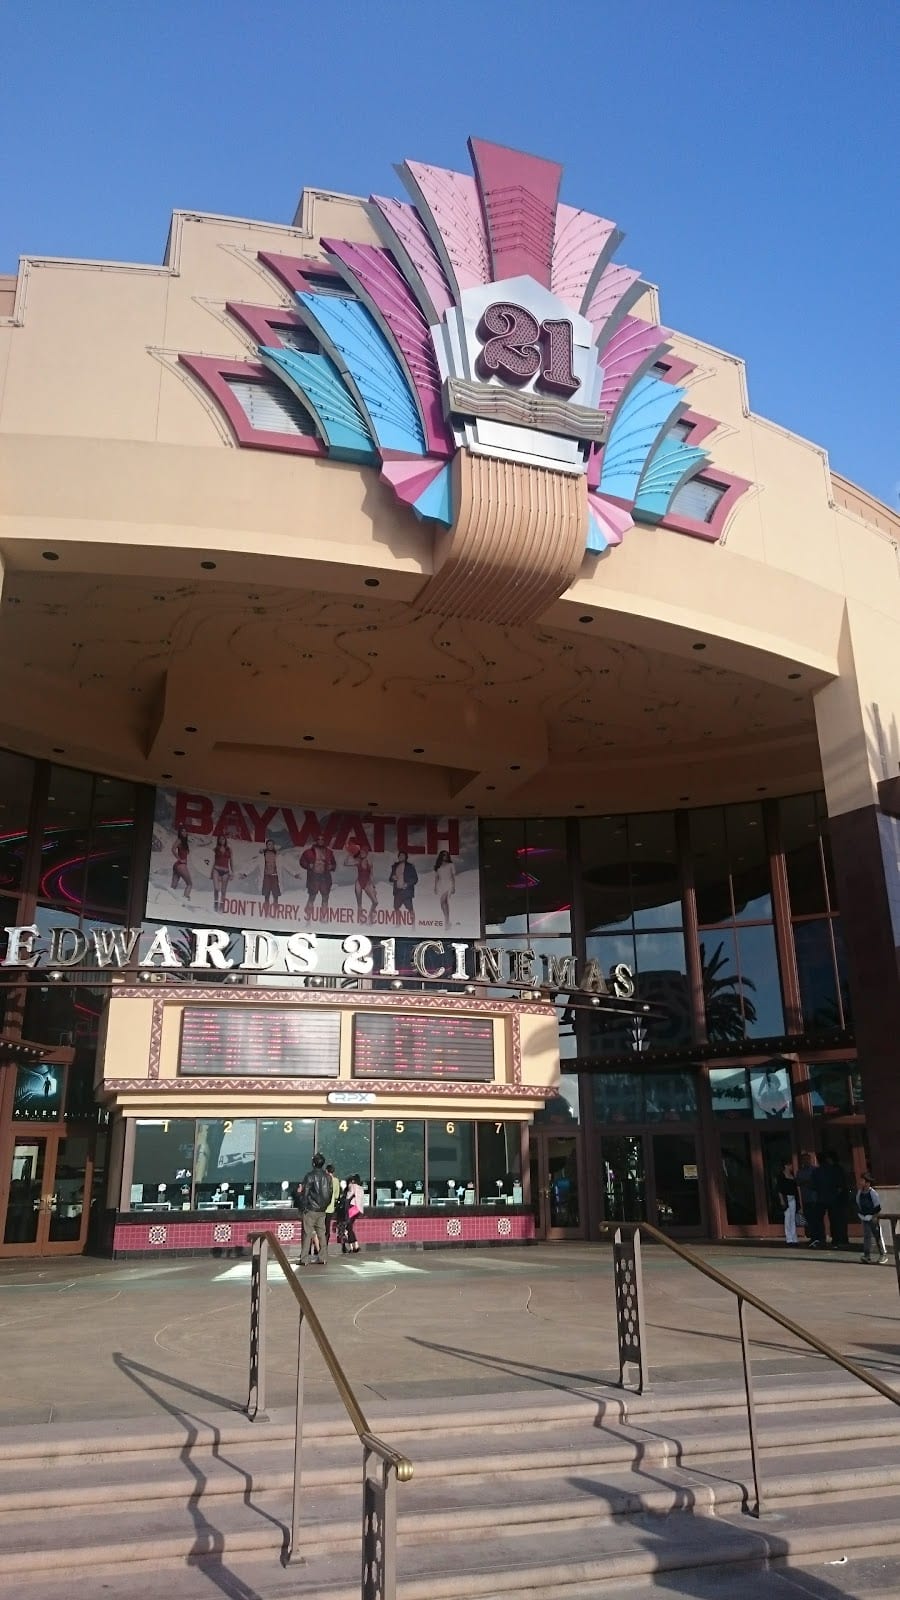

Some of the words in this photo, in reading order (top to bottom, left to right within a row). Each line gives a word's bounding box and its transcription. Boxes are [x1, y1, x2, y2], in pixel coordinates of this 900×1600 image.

[476, 302, 581, 396] 21
[174, 792, 460, 856] BAYWATCH
[222, 898, 257, 917] DON'T
[304, 906, 354, 924] SUMMER
[357, 908, 368, 924] IS
[371, 909, 416, 926] COMING
[3, 924, 318, 973] EDWARDS
[342, 934, 400, 975] 21
[411, 939, 636, 998] CINEMAS
[335, 1092, 368, 1102] RPX
[162, 1121, 170, 1133] 1
[223, 1120, 234, 1133] 2
[283, 1120, 294, 1133] 3
[338, 1120, 348, 1132] 4
[396, 1121, 405, 1133] 5
[446, 1121, 455, 1134] 6
[494, 1122, 503, 1134] 7
